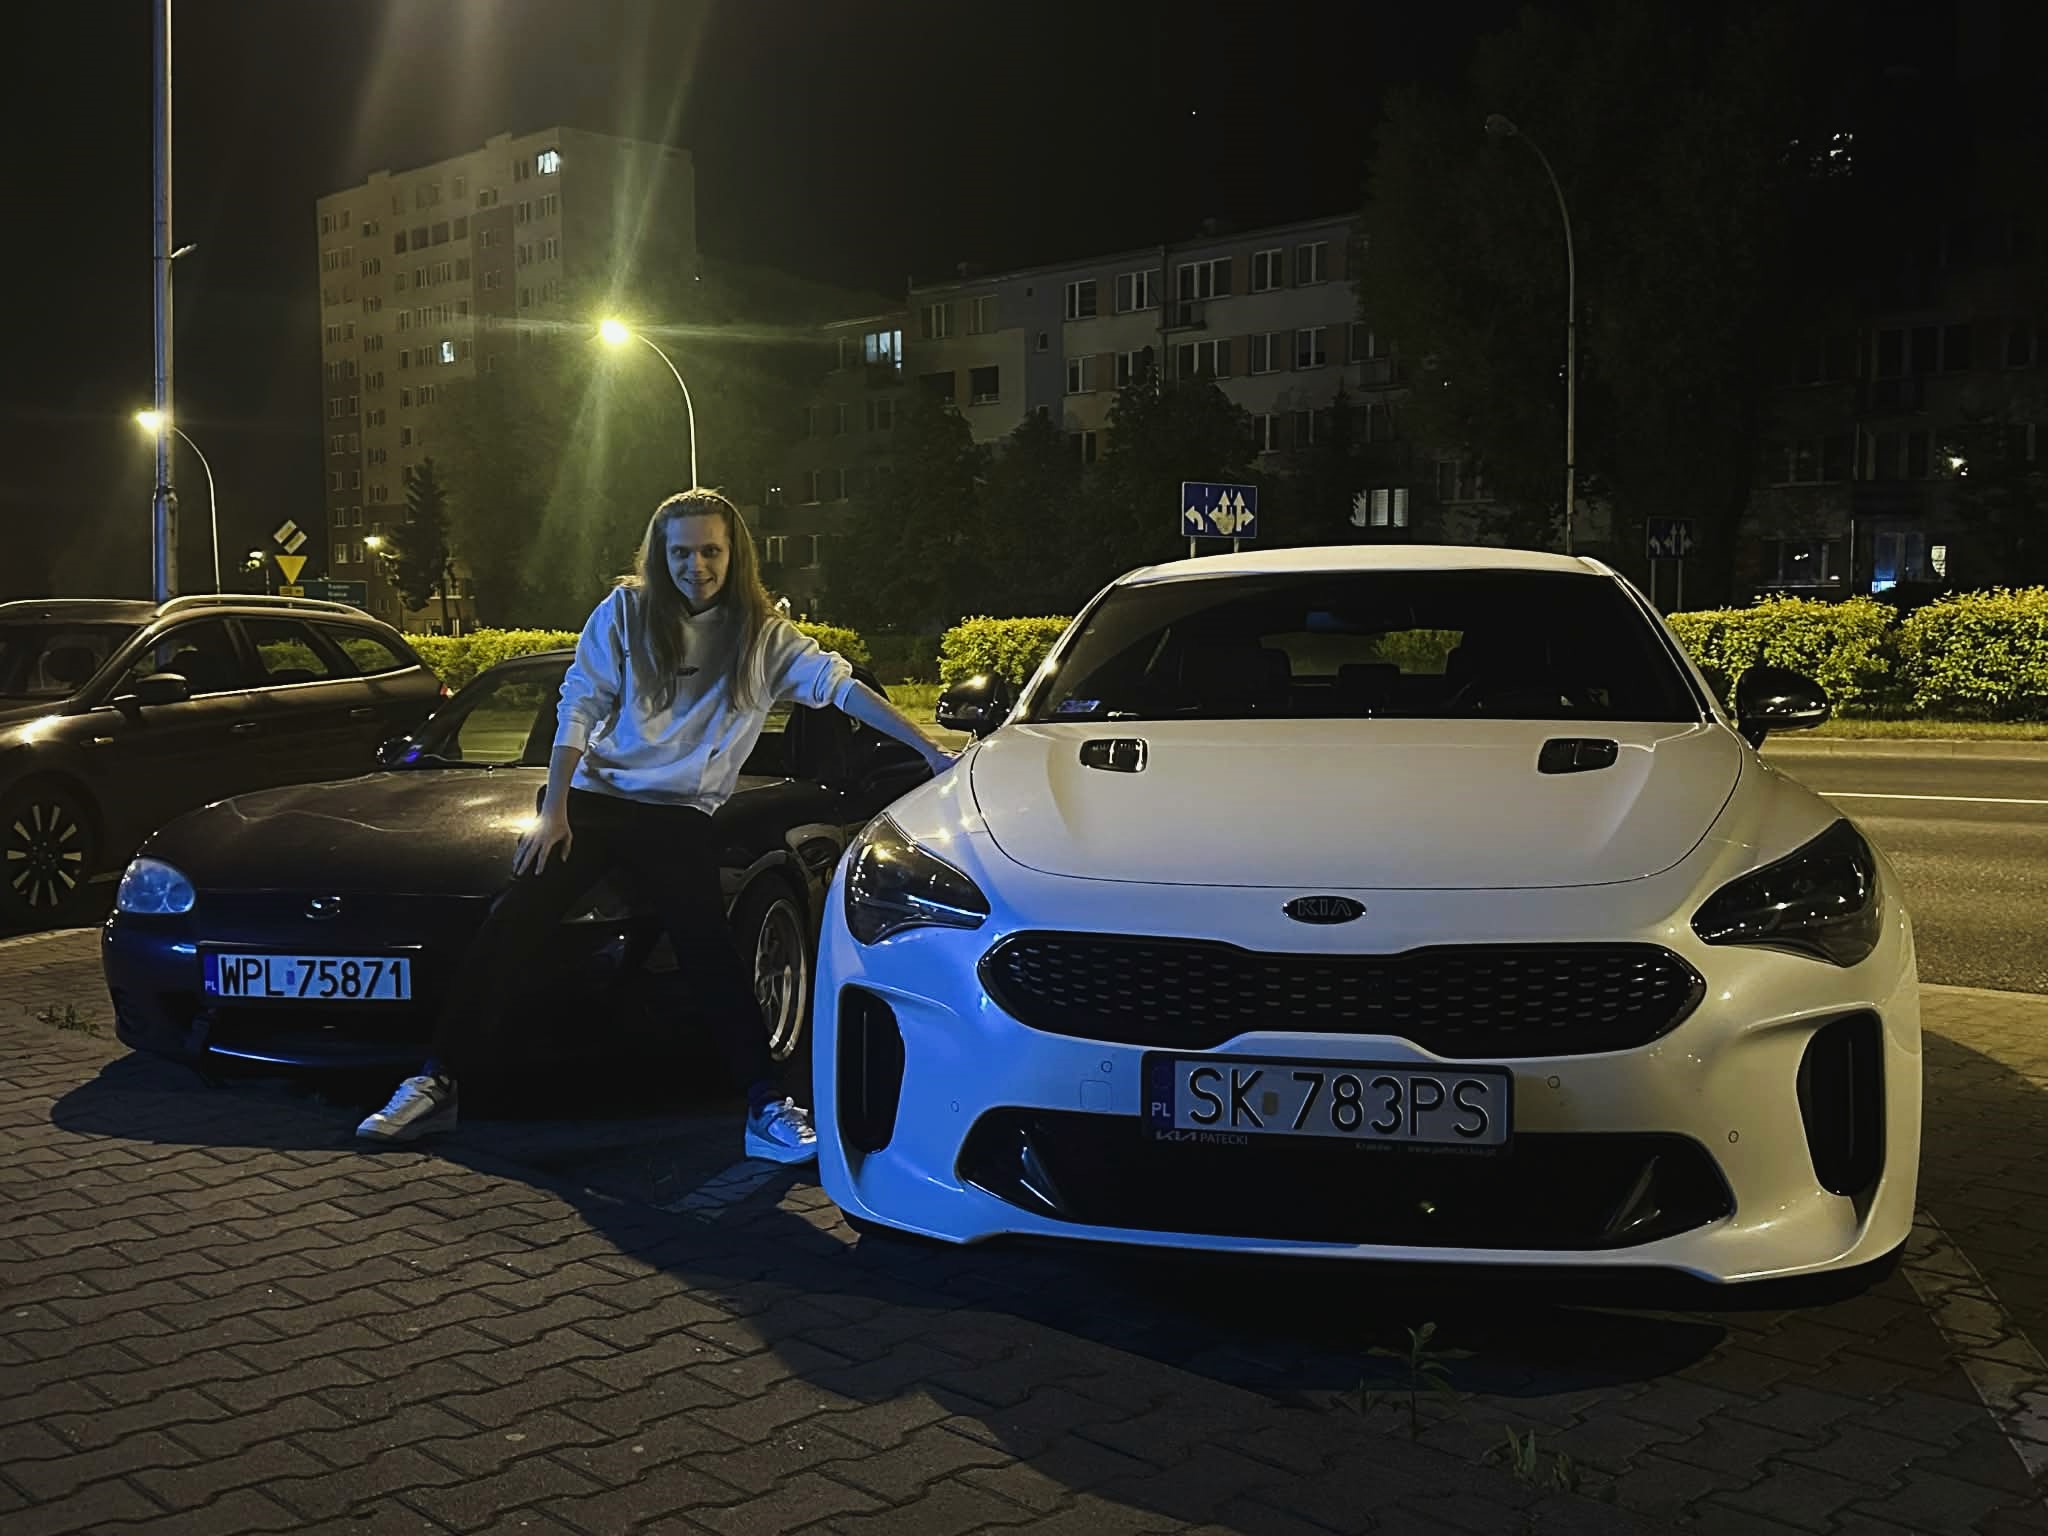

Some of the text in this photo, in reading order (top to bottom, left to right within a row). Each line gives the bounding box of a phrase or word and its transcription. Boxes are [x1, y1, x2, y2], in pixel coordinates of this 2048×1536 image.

[1296, 898, 1353, 917] KIA
[204, 980, 217, 992] PL
[220, 956, 402, 999] WPL 75871
[1151, 1102, 1172, 1118] PL
[1188, 1067, 1490, 1139] SK 783PS
[1155, 1129, 1249, 1145] KIA PATECKI
